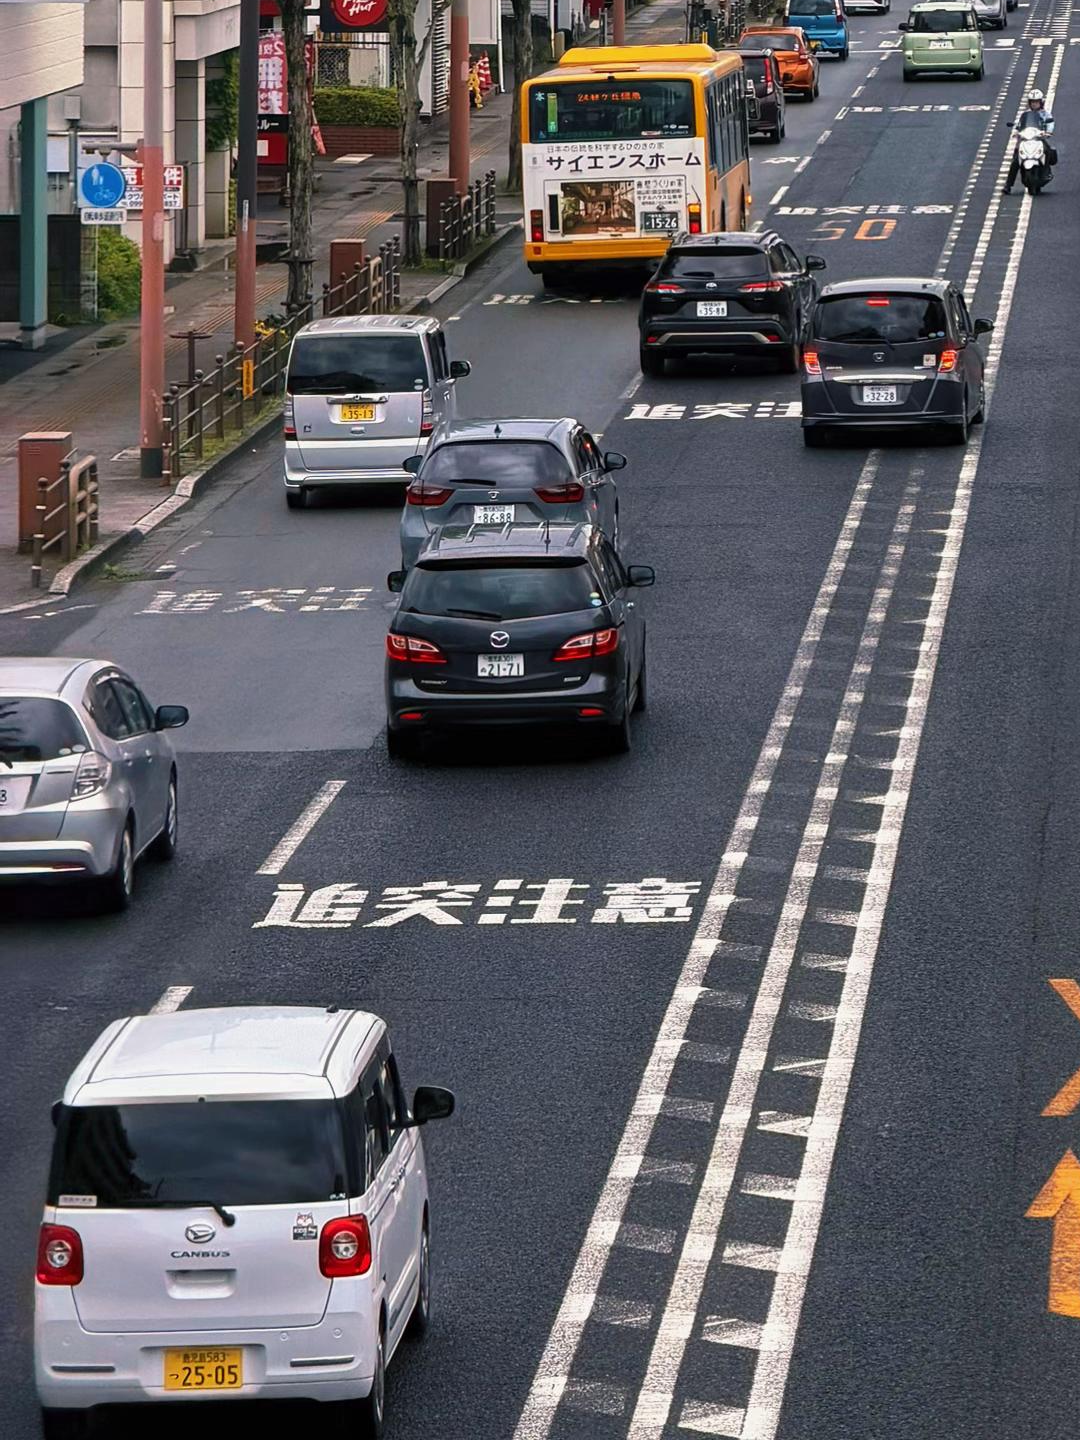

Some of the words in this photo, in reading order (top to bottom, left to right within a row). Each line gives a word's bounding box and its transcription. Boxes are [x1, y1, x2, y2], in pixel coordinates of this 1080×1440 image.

[349, 2, 376, 16] Hut
[546, 152, 702, 173] サイエンスホーム
[251, 878, 702, 928] 追突注意
[170, 1250, 231, 1259] CANBUS
[182, 1364, 238, 1387] 25-05
